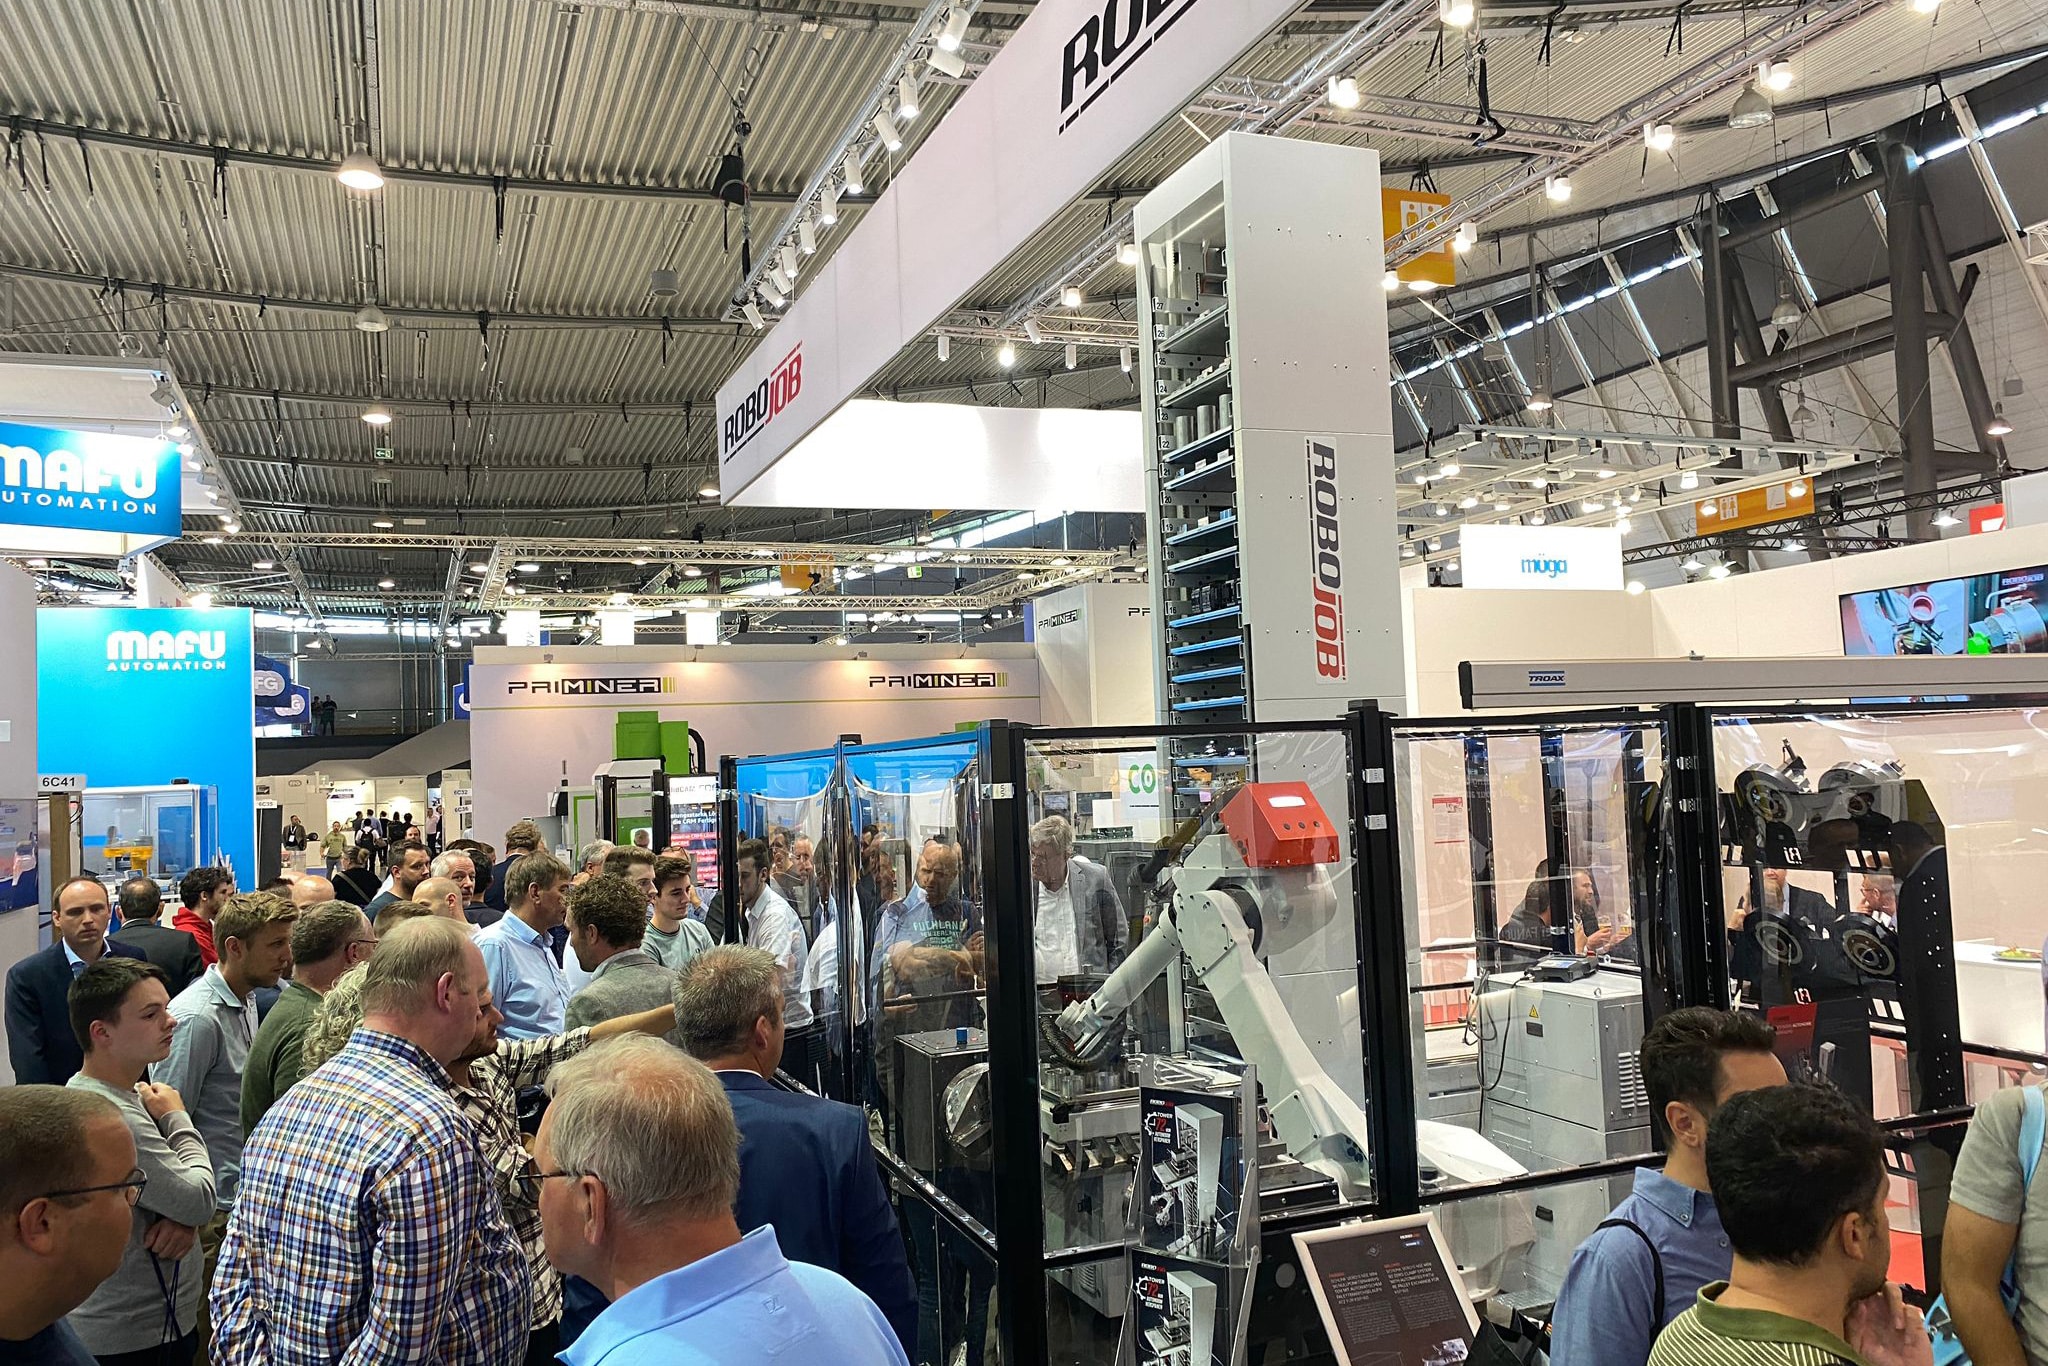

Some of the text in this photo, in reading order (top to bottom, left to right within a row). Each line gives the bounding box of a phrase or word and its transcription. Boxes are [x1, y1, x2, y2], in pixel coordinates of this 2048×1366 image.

[1061, 0, 1176, 114] RO
[1157, 302, 1163, 310] 27
[1159, 357, 1166, 365] 25
[1160, 385, 1168, 393] 24
[724, 353, 802, 455] ROBOJOB
[1161, 412, 1169, 420] 23
[1162, 441, 1170, 449] 22
[0, 489, 158, 515] UTOMATION
[1165, 496, 1172, 504] 20
[1166, 523, 1173, 531] 19
[1167, 551, 1175, 559] 18
[1312, 442, 1341, 679] ROBOJOB
[1521, 553, 1568, 578] müga
[1169, 579, 1176, 587] 17
[1169, 606, 1177, 614] 16
[1038, 609, 1078, 629] PRIMINER
[106, 630, 226, 660] MAFU
[107, 660, 226, 672] AUTOMATION
[508, 677, 661, 695] PRIMINER
[869, 672, 996, 688] PRIMINER
[1174, 716, 1182, 724] 12
[42, 776, 76, 787] 6C41
[1128, 763, 1156, 794] CO
[1155, 1118, 1168, 1132] 72
[1147, 1282, 1159, 1298] 72
